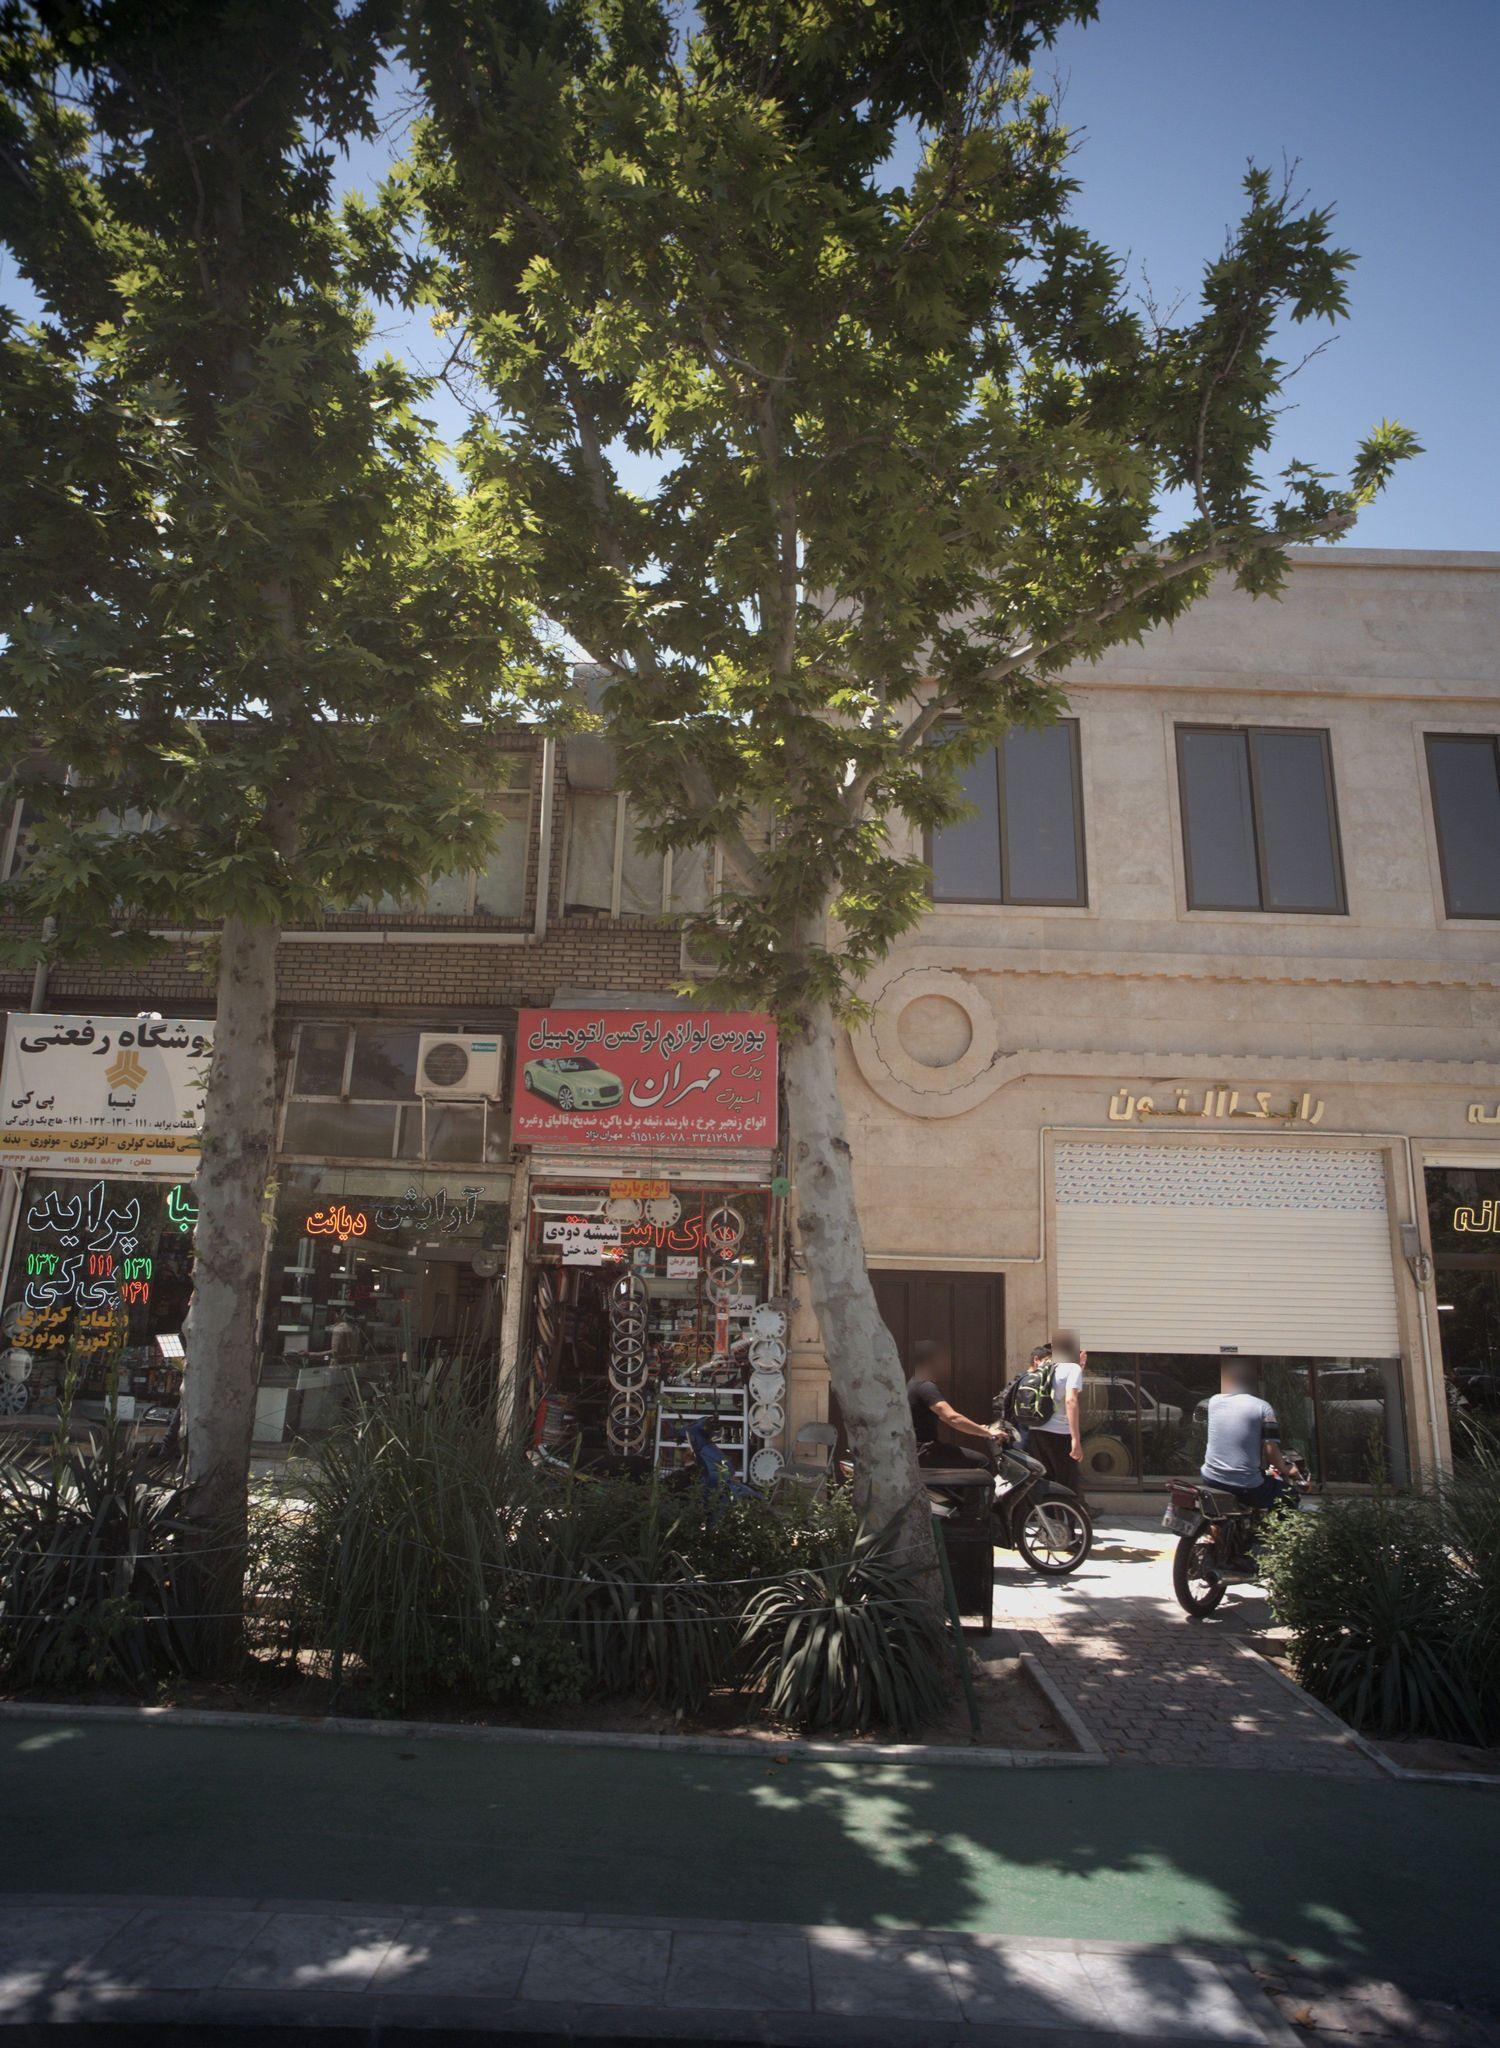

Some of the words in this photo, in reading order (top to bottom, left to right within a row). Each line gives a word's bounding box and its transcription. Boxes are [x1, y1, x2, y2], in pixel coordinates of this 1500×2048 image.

[20, 1019, 111, 1055] رفعتی
[118, 1022, 215, 1058] وشگاه
[528, 1018, 605, 1053] اتومبیل
[604, 1019, 661, 1054] لوکس
[660, 1019, 710, 1061] لوازم
[709, 1029, 766, 1055] بورس
[731, 1054, 766, 1081] یدک
[628, 1060, 721, 1109] مهران
[11, 1090, 35, 1109] کی
[36, 1095, 55, 1111] پی
[108, 1092, 137, 1112] تیبا
[715, 1090, 761, 1113] اسپرت
[718, 1116, 743, 1131] زنجیر
[743, 1116, 767, 1131] انواع
[117, 1137, 145, 1152] کولری
[146, 1137, 176, 1149] قطعات
[642, 1180, 670, 1199] انواع
[27, 1180, 140, 1255] پراید
[375, 1186, 485, 1233] آرایش
[306, 1204, 367, 1241] دیانت
[545, 1225, 581, 1241] دودی
[583, 1224, 620, 1245] شیشه
[561, 1244, 581, 1257] خش
[583, 1245, 598, 1256] ضد
[27, 1253, 60, 1276] ۱۳۲
[89, 1253, 114, 1276] ۱۱۱
[123, 1257, 152, 1280] ۱۳۱
[25, 1253, 85, 1310] کی
[12, 1327, 65, 1351] موتوری
